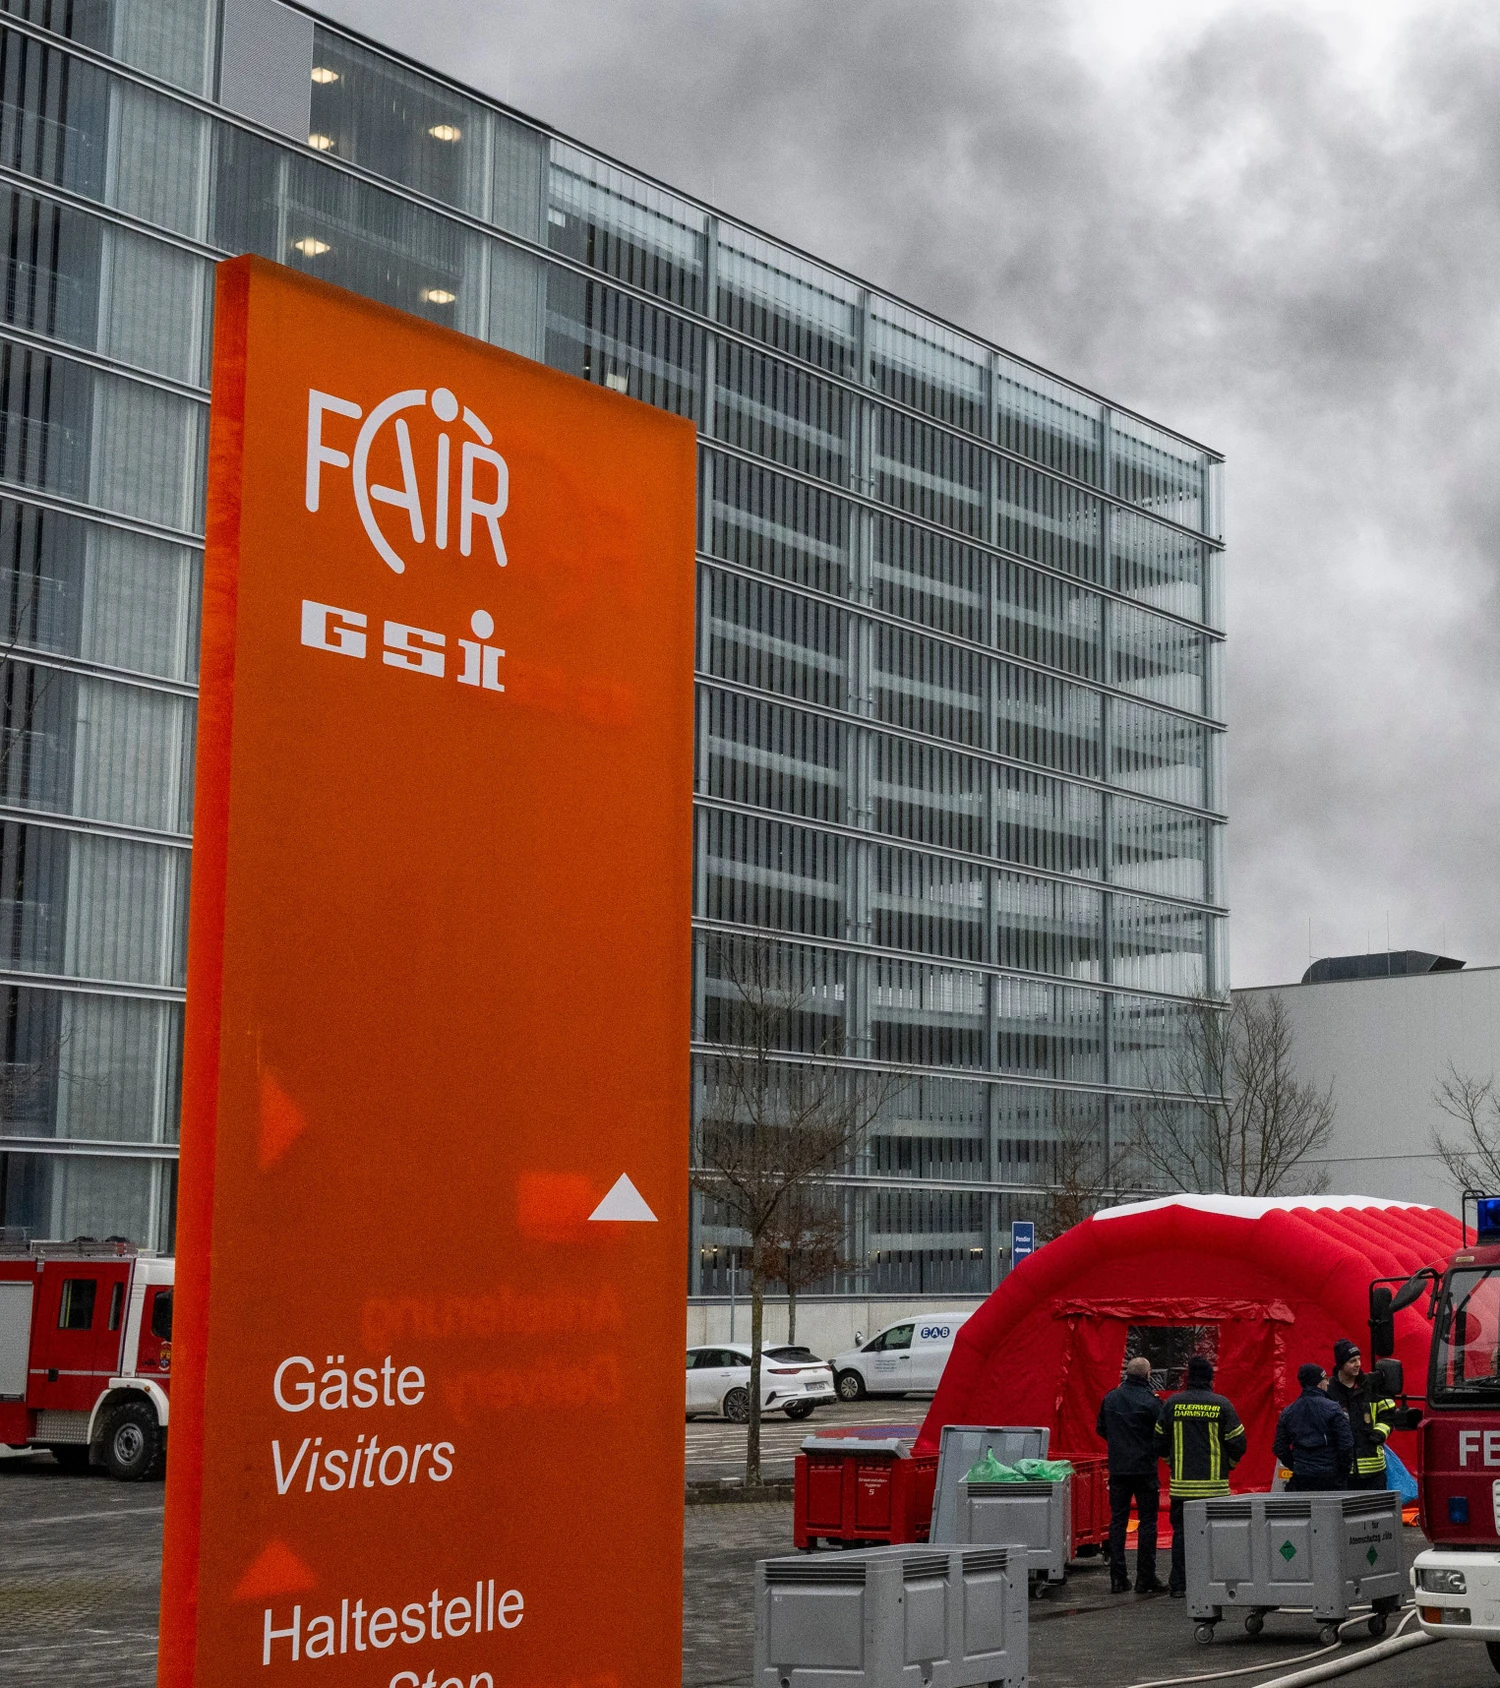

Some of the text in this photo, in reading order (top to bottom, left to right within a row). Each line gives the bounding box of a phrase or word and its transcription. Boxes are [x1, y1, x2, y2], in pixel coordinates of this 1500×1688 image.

[305, 387, 509, 575] FAIR
[921, 1327, 950, 1338] EAB
[273, 1354, 425, 1413] Gäste
[271, 1434, 455, 1495] Visitors
[262, 1579, 524, 1666] Haltestelle
